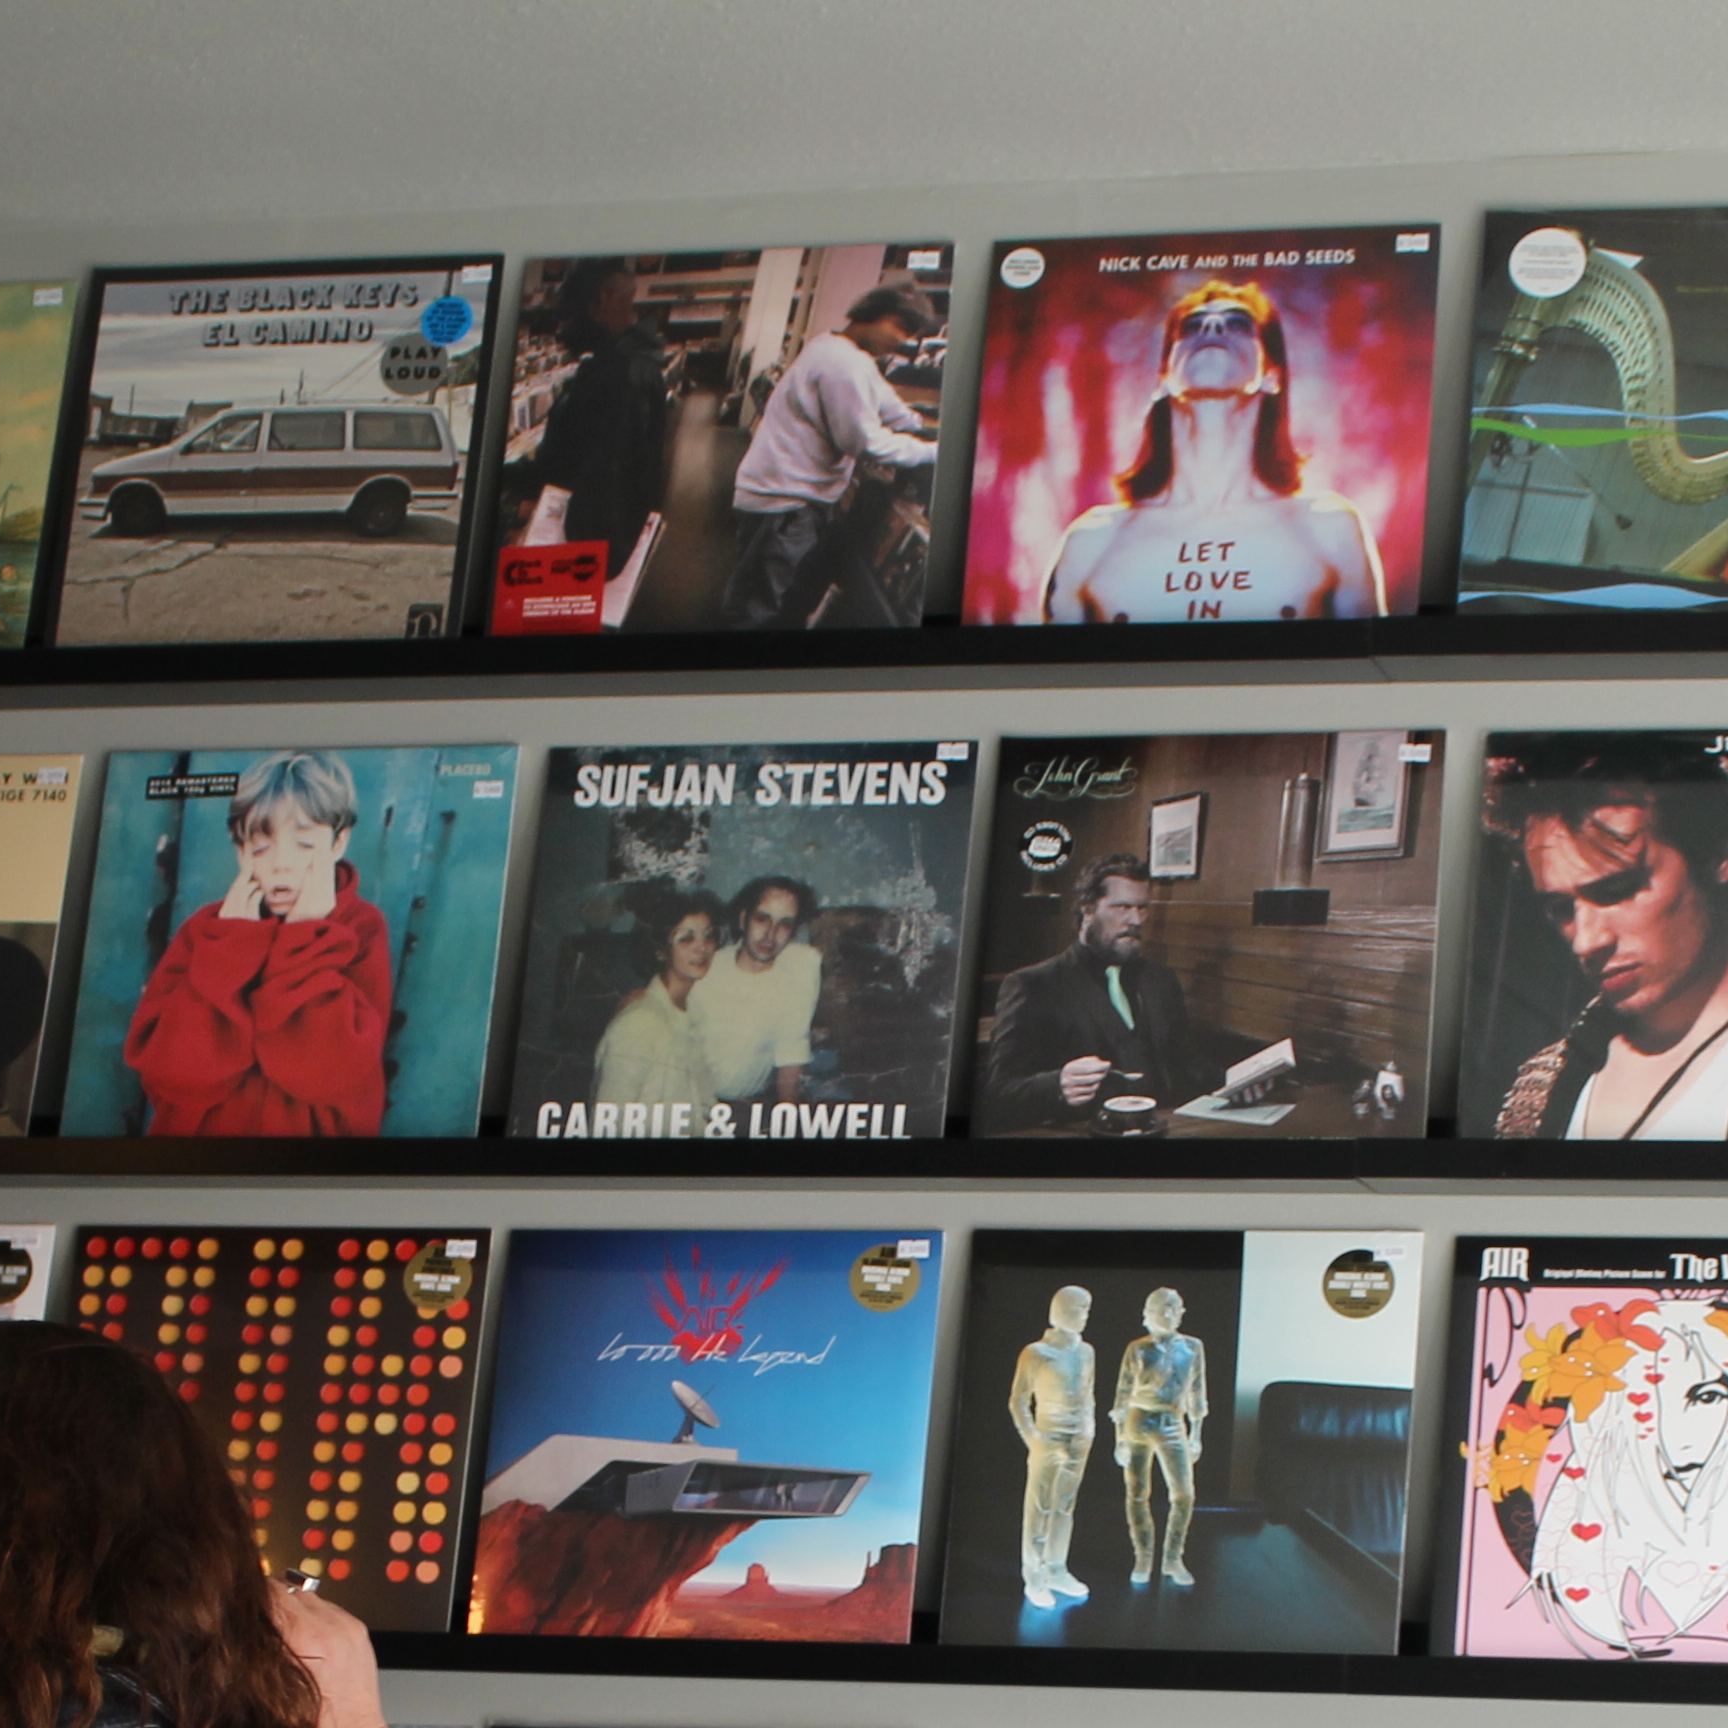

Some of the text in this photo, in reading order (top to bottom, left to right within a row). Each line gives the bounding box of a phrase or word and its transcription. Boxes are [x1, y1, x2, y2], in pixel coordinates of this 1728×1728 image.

[1099, 249, 1356, 273] NICK CAVE AND THE BAD SEEDS
[171, 281, 419, 315] THE BLACK KEYS
[202, 317, 375, 347] EL CAMINO
[389, 345, 441, 361] PLAY
[384, 366, 442, 380] LOUD
[1178, 541, 1235, 563] LET
[1165, 571, 1252, 593] LOVE
[1188, 600, 1222, 620] IN
[440, 763, 491, 776] PLACEBO
[1013, 755, 1138, 798] John Grant
[32, 788, 67, 801] 7140
[574, 762, 947, 808] SUFJAN STEVENS
[536, 1102, 911, 1140] CARRIE & LOWELL
[1479, 1247, 1531, 1281] AIR
[1670, 1254, 1718, 1283] The
